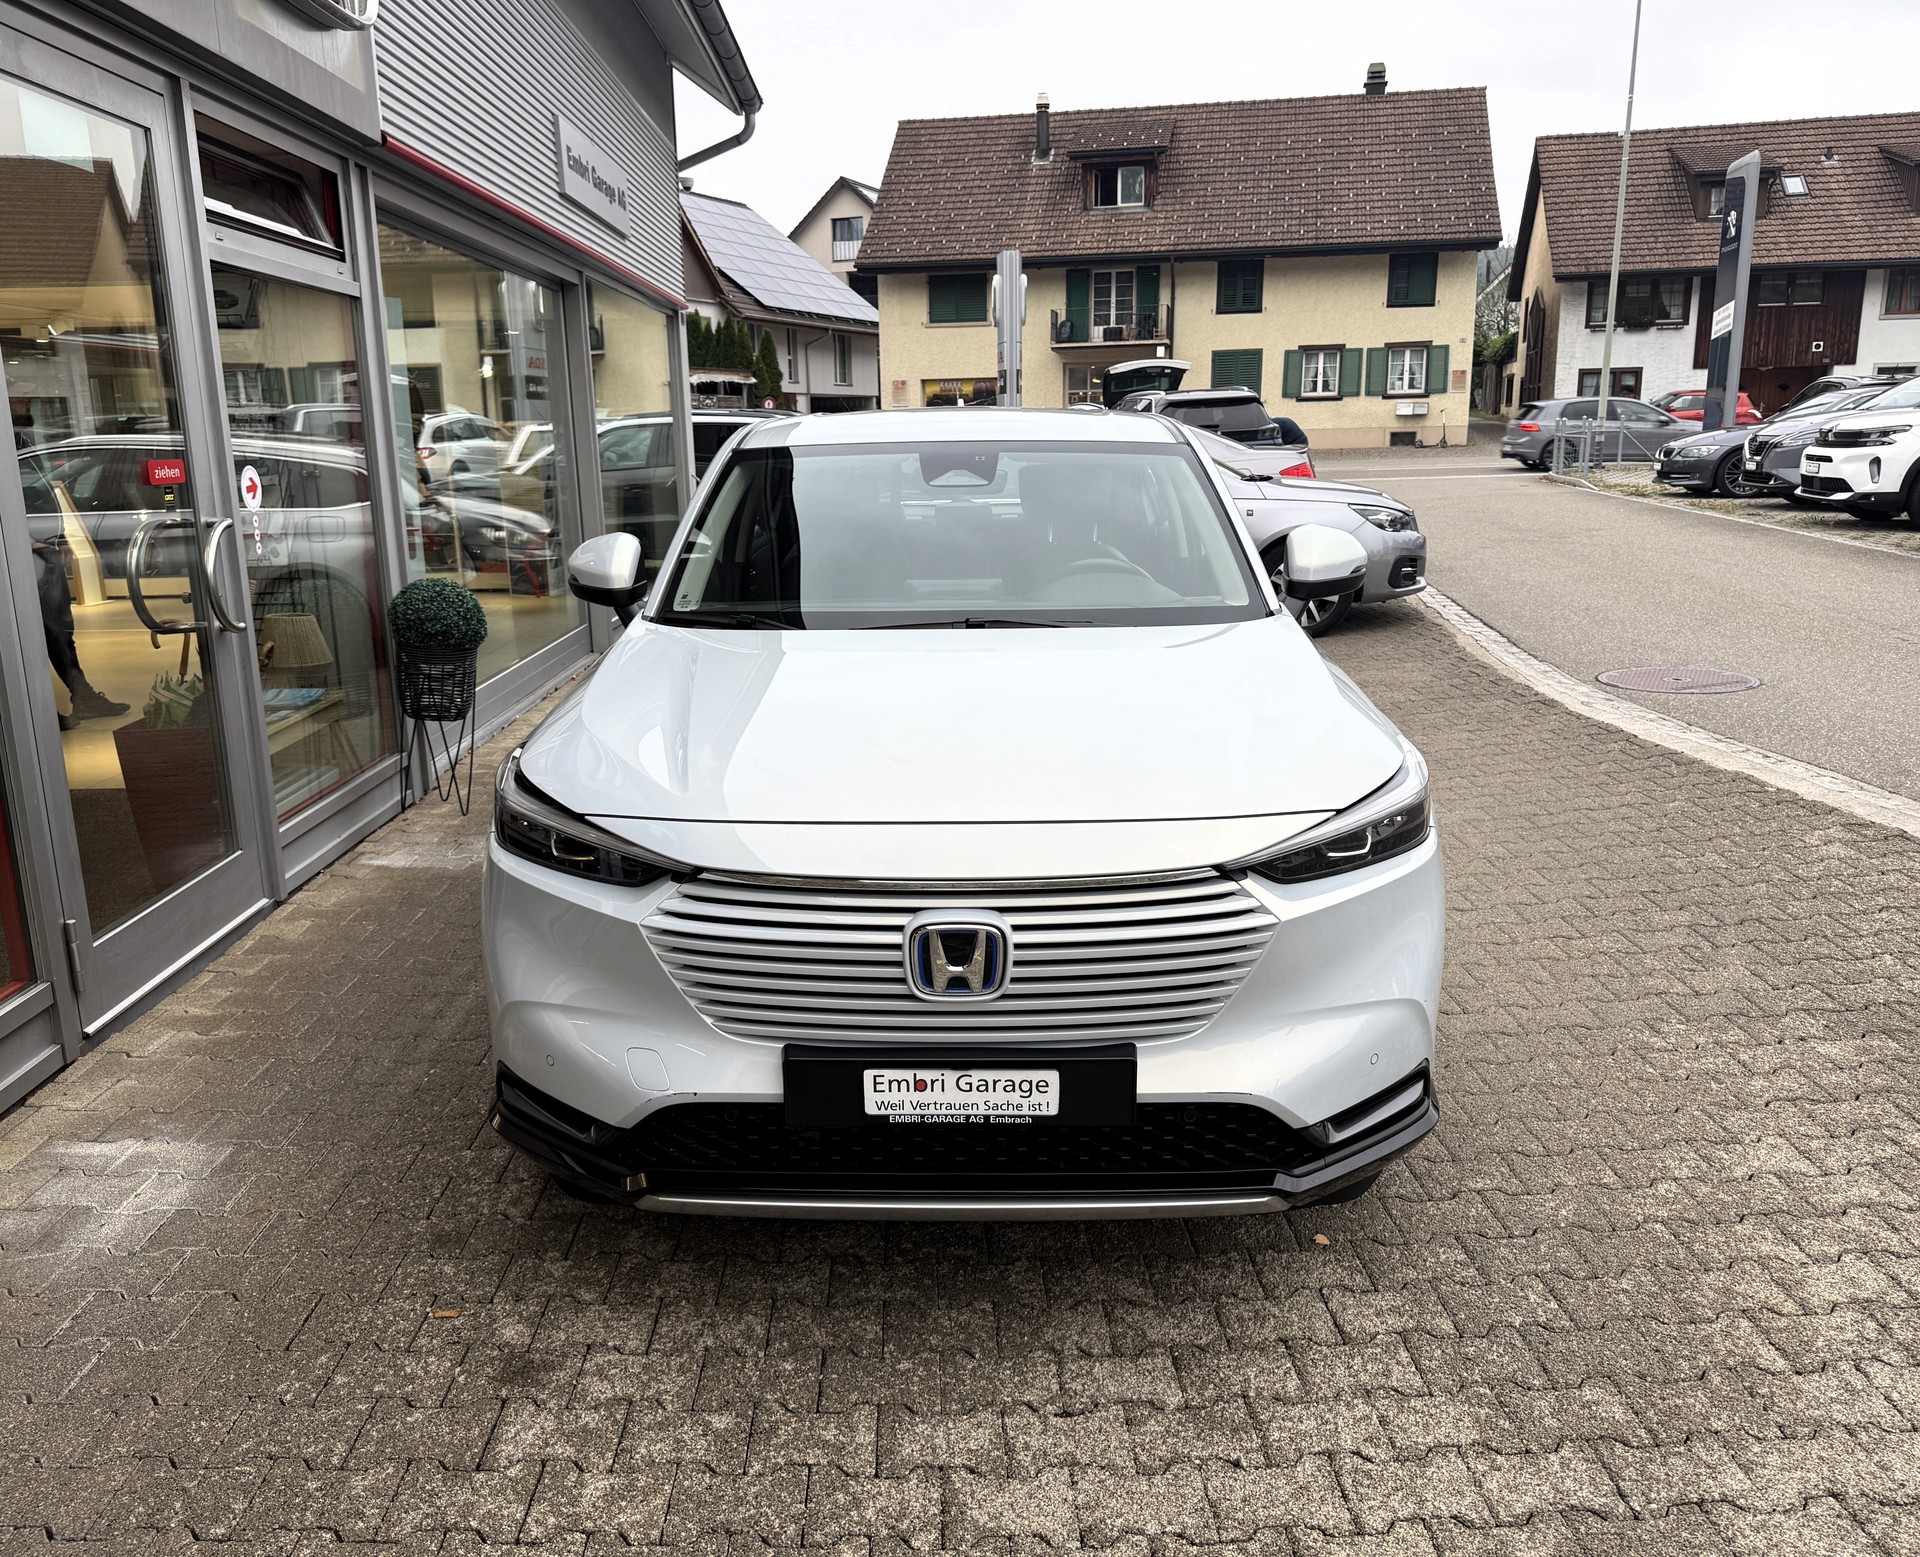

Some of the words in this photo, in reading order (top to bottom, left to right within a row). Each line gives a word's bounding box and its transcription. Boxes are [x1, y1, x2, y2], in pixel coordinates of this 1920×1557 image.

[566, 144, 590, 184] Embri
[591, 165, 617, 206] Garage
[617, 187, 627, 212] AG
[154, 465, 181, 479] ziehen
[873, 1073, 945, 1093] Embri
[955, 1074, 1050, 1099] Garage
[875, 1100, 905, 1112] Weil
[910, 1100, 979, 1112] Vertrauen
[984, 1100, 1024, 1112] Sache
[889, 1115, 966, 1123] EMBRI-GARAGE
[969, 1115, 984, 1123] AG
[990, 1115, 1032, 1124] Embrach
